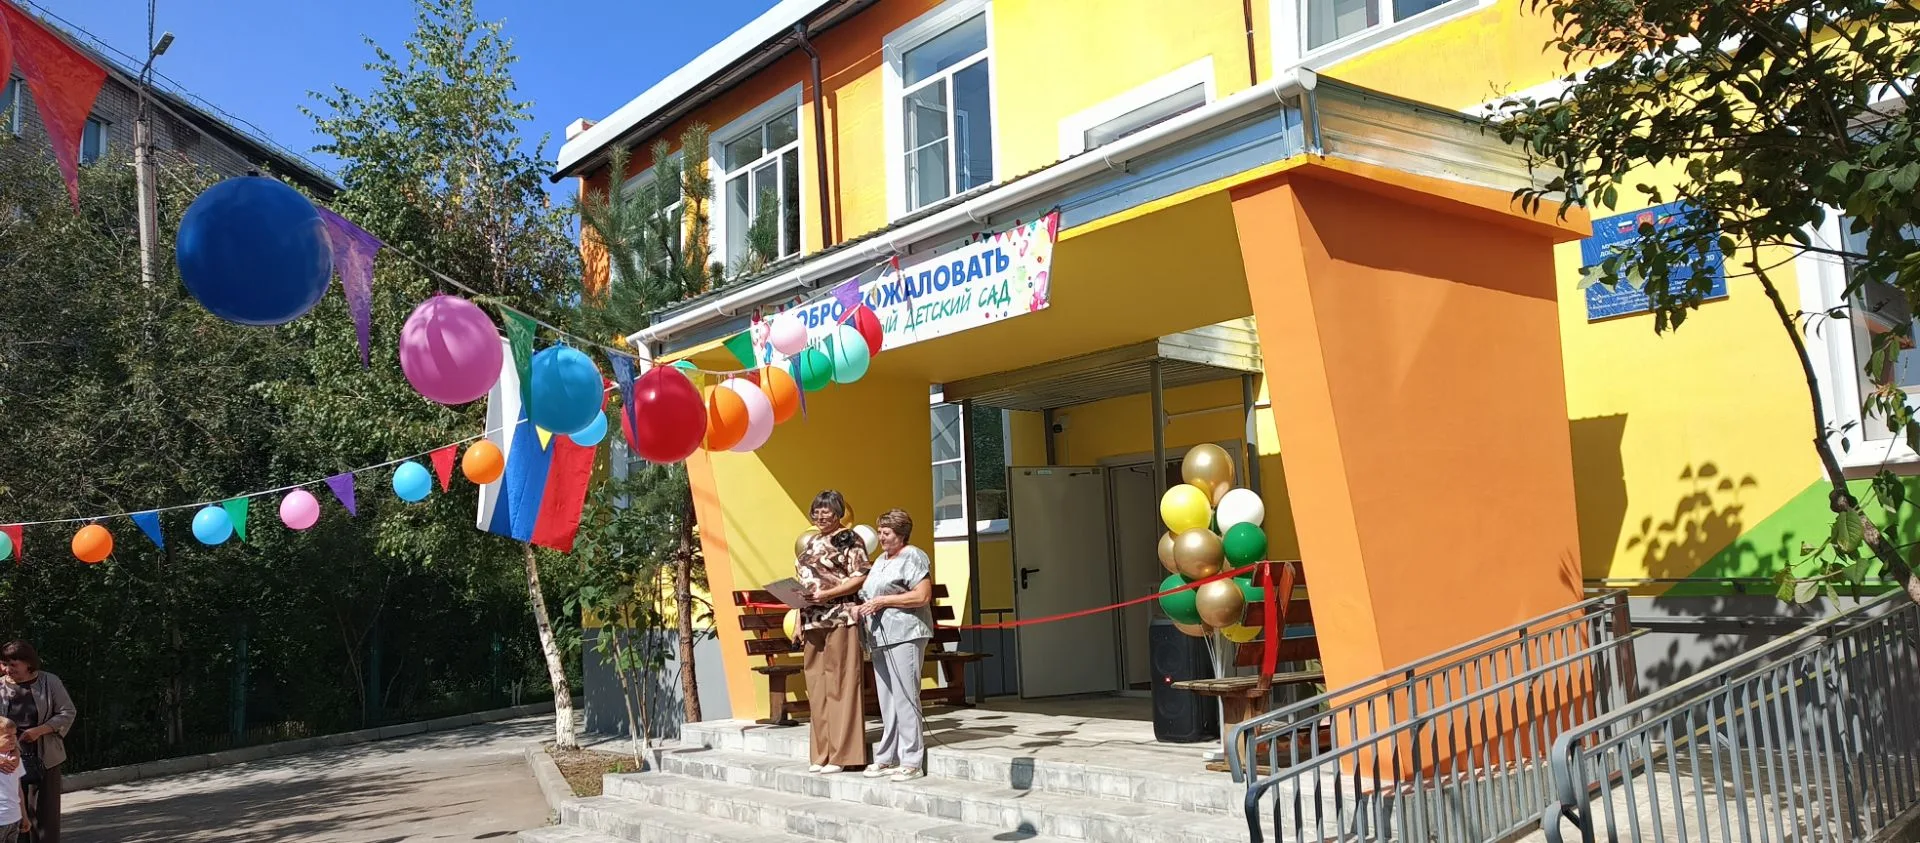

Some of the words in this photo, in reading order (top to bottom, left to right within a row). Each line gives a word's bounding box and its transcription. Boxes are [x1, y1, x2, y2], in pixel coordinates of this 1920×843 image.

[858, 247, 1010, 312] ОЖАЛОВАТЬ
[904, 287, 972, 334] ДЕТСКИЙ
[978, 279, 1011, 309] САД
